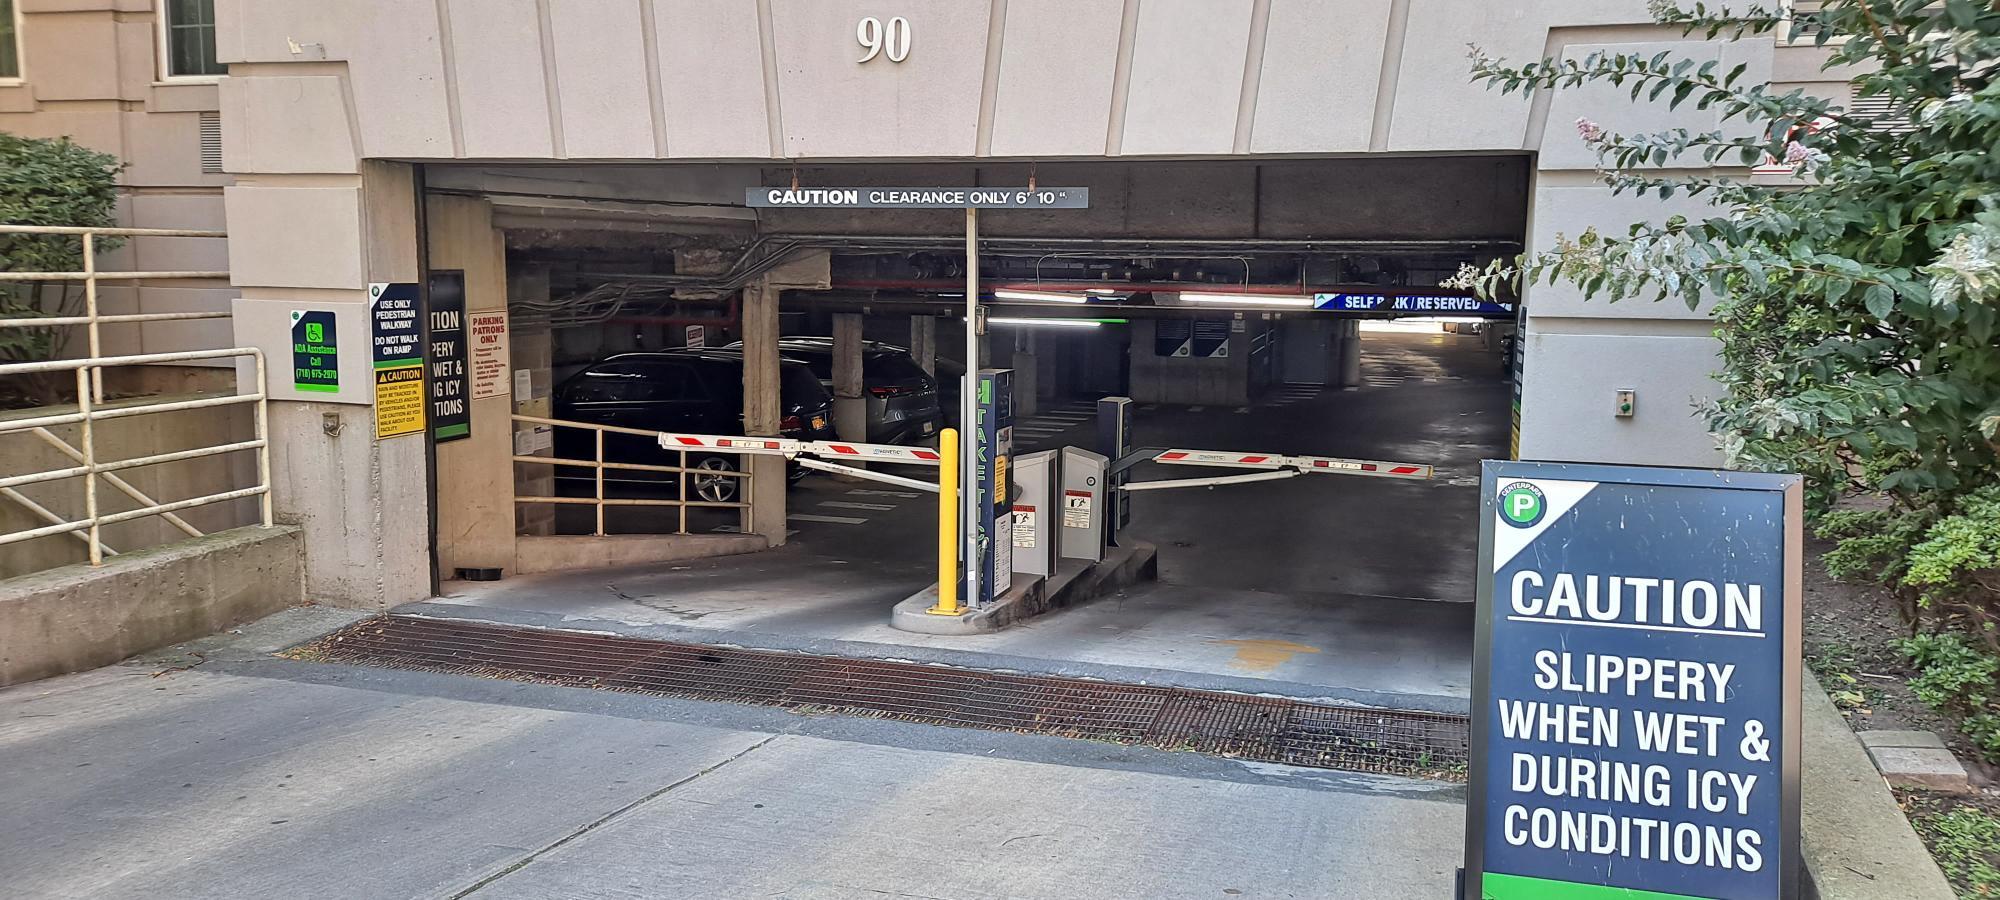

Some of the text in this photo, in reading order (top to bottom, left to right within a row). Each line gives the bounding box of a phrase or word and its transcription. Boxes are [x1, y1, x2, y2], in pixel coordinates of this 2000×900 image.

[856, 16, 911, 63] 90
[768, 190, 858, 205] CAUTION
[869, 191, 967, 205] CLEARANCE
[970, 191, 1010, 205] ONLY
[380, 300, 411, 309] USE ONLY
[1345, 295, 1374, 309] SELF
[1377, 296, 1409, 309] PRK
[1417, 297, 1481, 310] RESERVED
[376, 310, 416, 319] PEDESTRIAN
[431, 310, 460, 329] TION
[473, 316, 504, 326] PARKING
[380, 320, 412, 329] WALKWAY
[473, 325, 505, 335] PATRONS
[375, 335, 418, 345] DO NOT WALK
[480, 335, 498, 344] ONLY
[294, 343, 337, 354] ADA Assistance
[383, 345, 411, 355] ON RAMP
[310, 357, 322, 366] Call
[433, 359, 463, 378] WET &
[387, 369, 420, 381] CAUTION
[446, 380, 460, 396] ICY
[1501, 483, 1543, 498] CENTERPARK
[1513, 494, 1535, 517] P
[1510, 570, 1762, 631] CAUTION
[1534, 650, 1736, 704] SLIPPERY
[1498, 699, 1771, 762] WHEN WET &
[1511, 752, 1758, 815] DURING ICY
[1504, 803, 1763, 873] CONDITIONS
